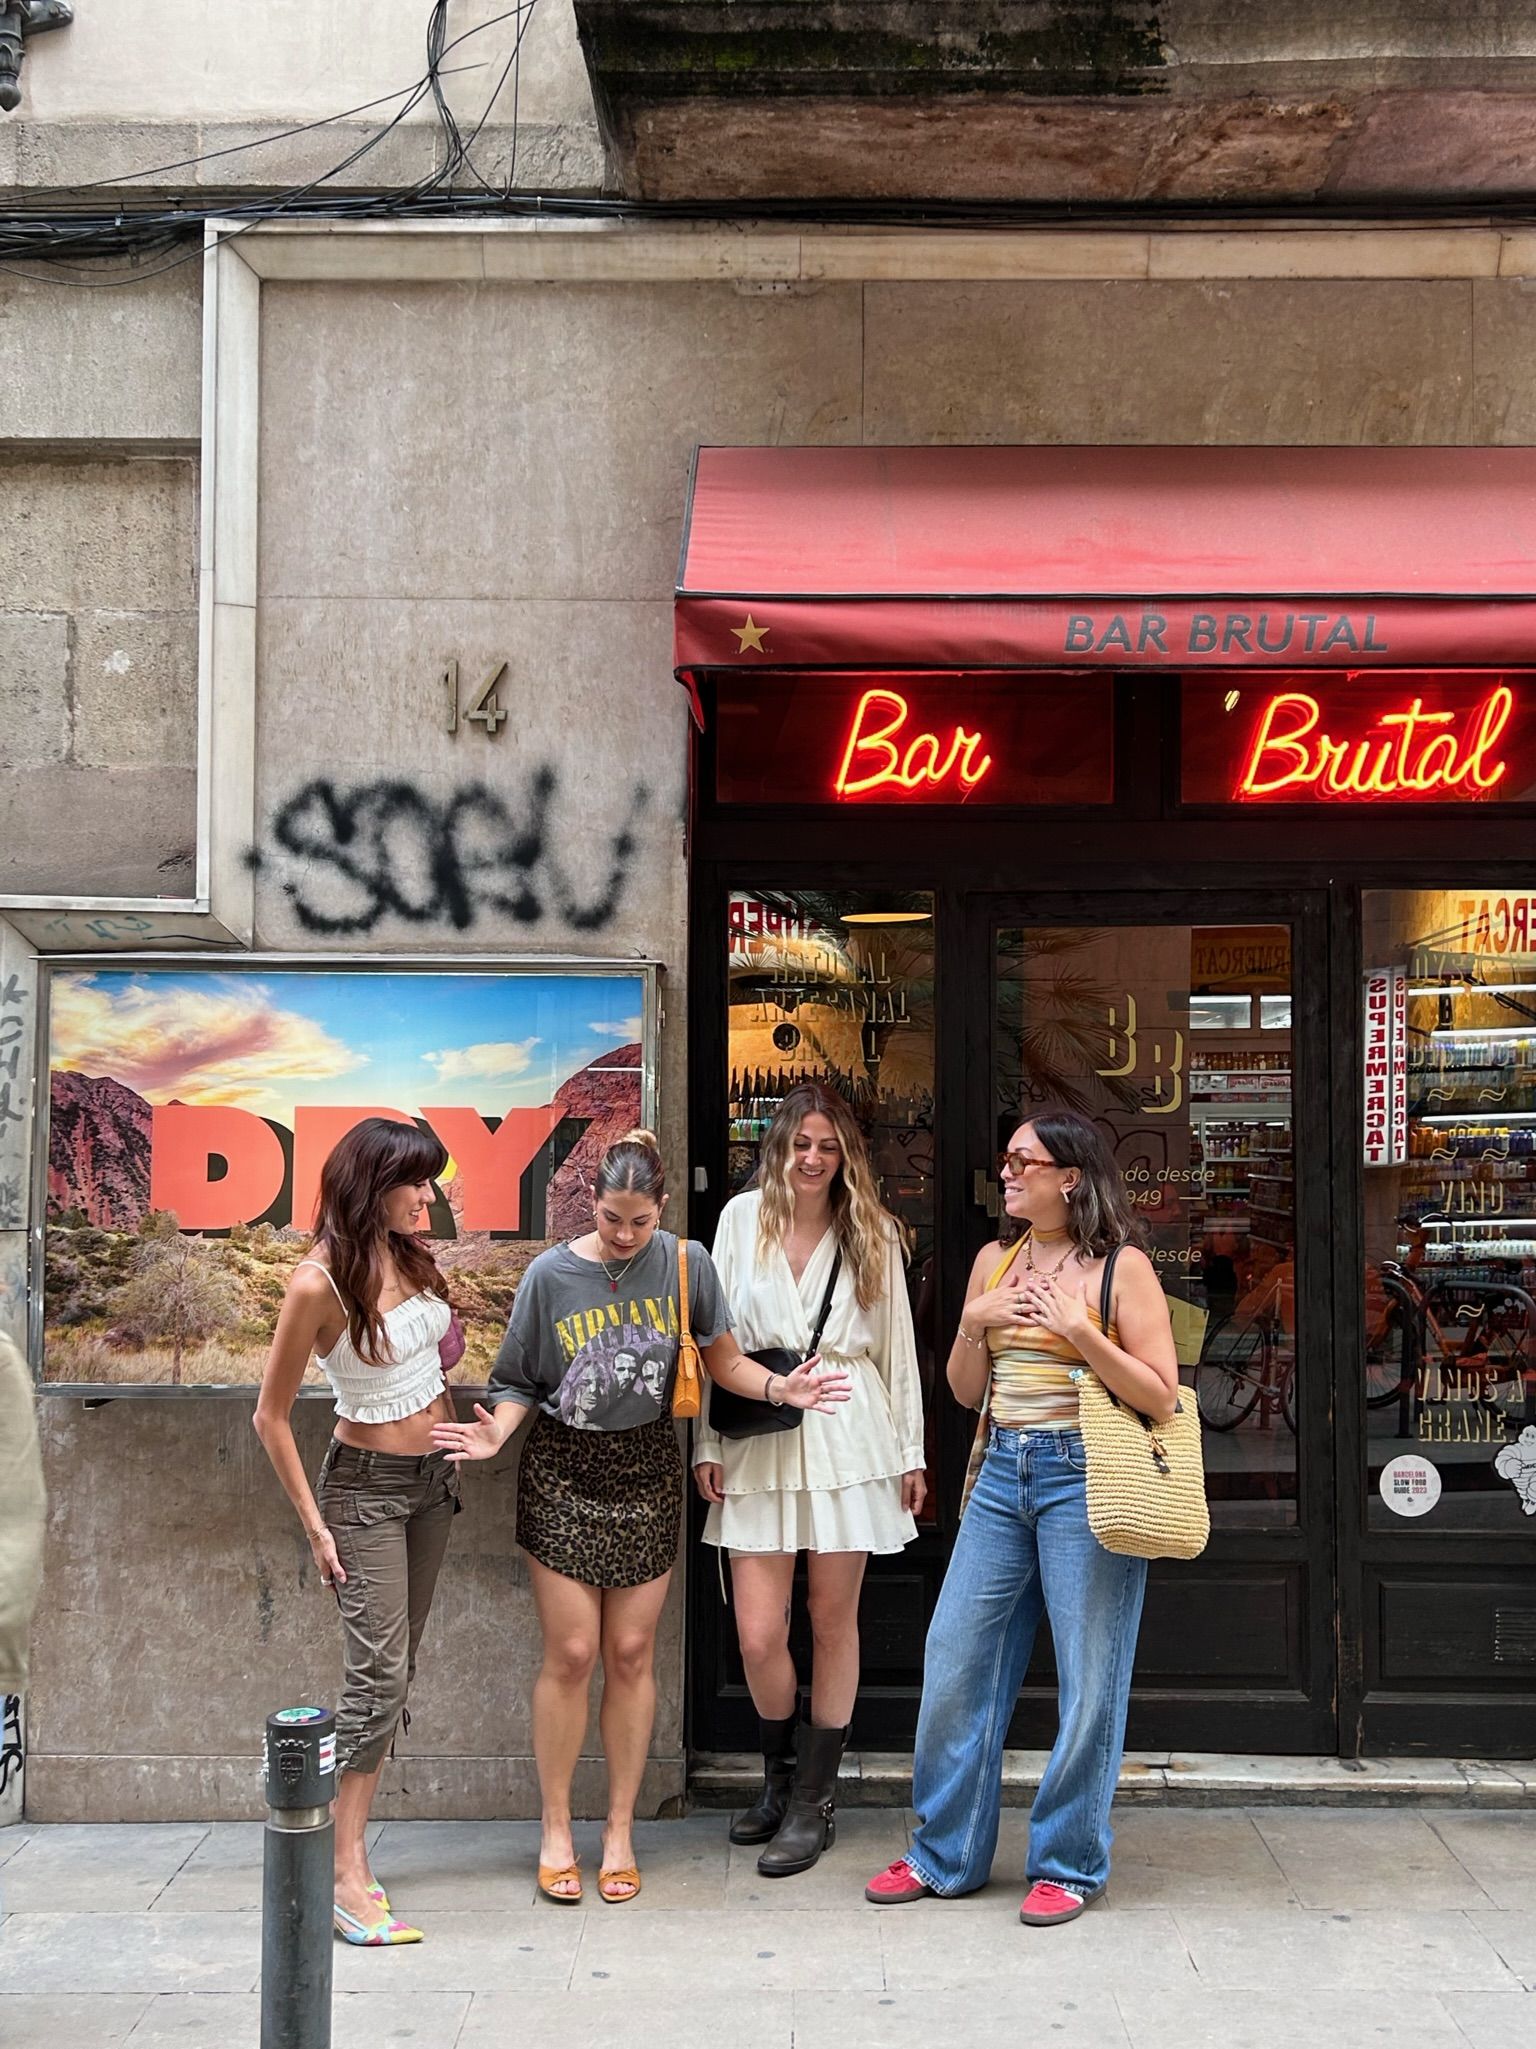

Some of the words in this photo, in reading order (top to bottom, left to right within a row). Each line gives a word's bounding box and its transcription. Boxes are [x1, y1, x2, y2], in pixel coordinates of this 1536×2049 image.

[1064, 613, 1169, 654] BAR
[1187, 612, 1389, 654] BRUTAL
[444, 658, 510, 734] 14
[834, 688, 993, 795] Bar
[1241, 686, 1514, 795] Brutal
[1156, 1166, 1216, 1182] desde
[555, 1295, 680, 1362] NIRVANA
